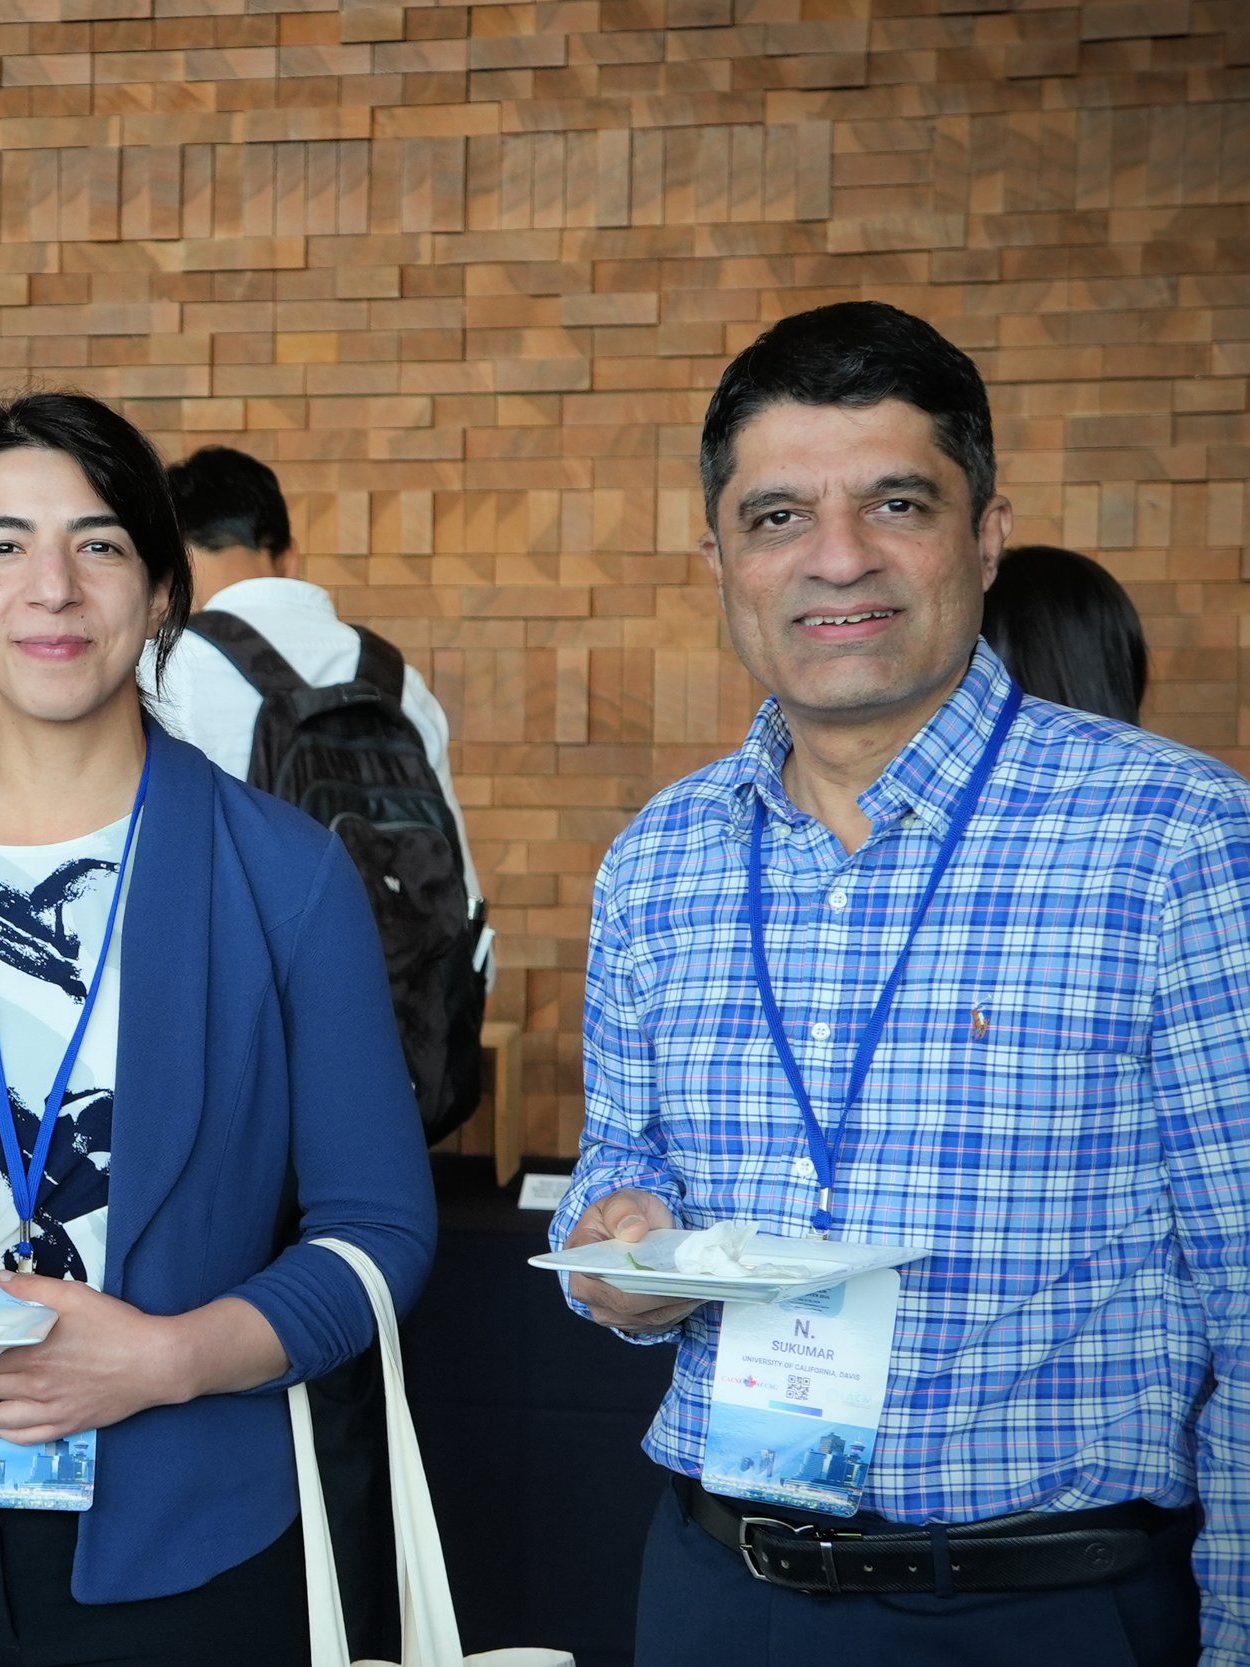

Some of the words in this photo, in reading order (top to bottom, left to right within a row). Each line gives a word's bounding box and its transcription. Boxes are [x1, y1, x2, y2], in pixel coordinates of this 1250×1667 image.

[794, 1318, 815, 1339] N.
[771, 1340, 835, 1361] SUKUMAR
[742, 1355, 783, 1368] UNIVERSITY
[794, 1363, 838, 1378] CALIFORNIA,
[839, 1370, 861, 1381] DAVIS
